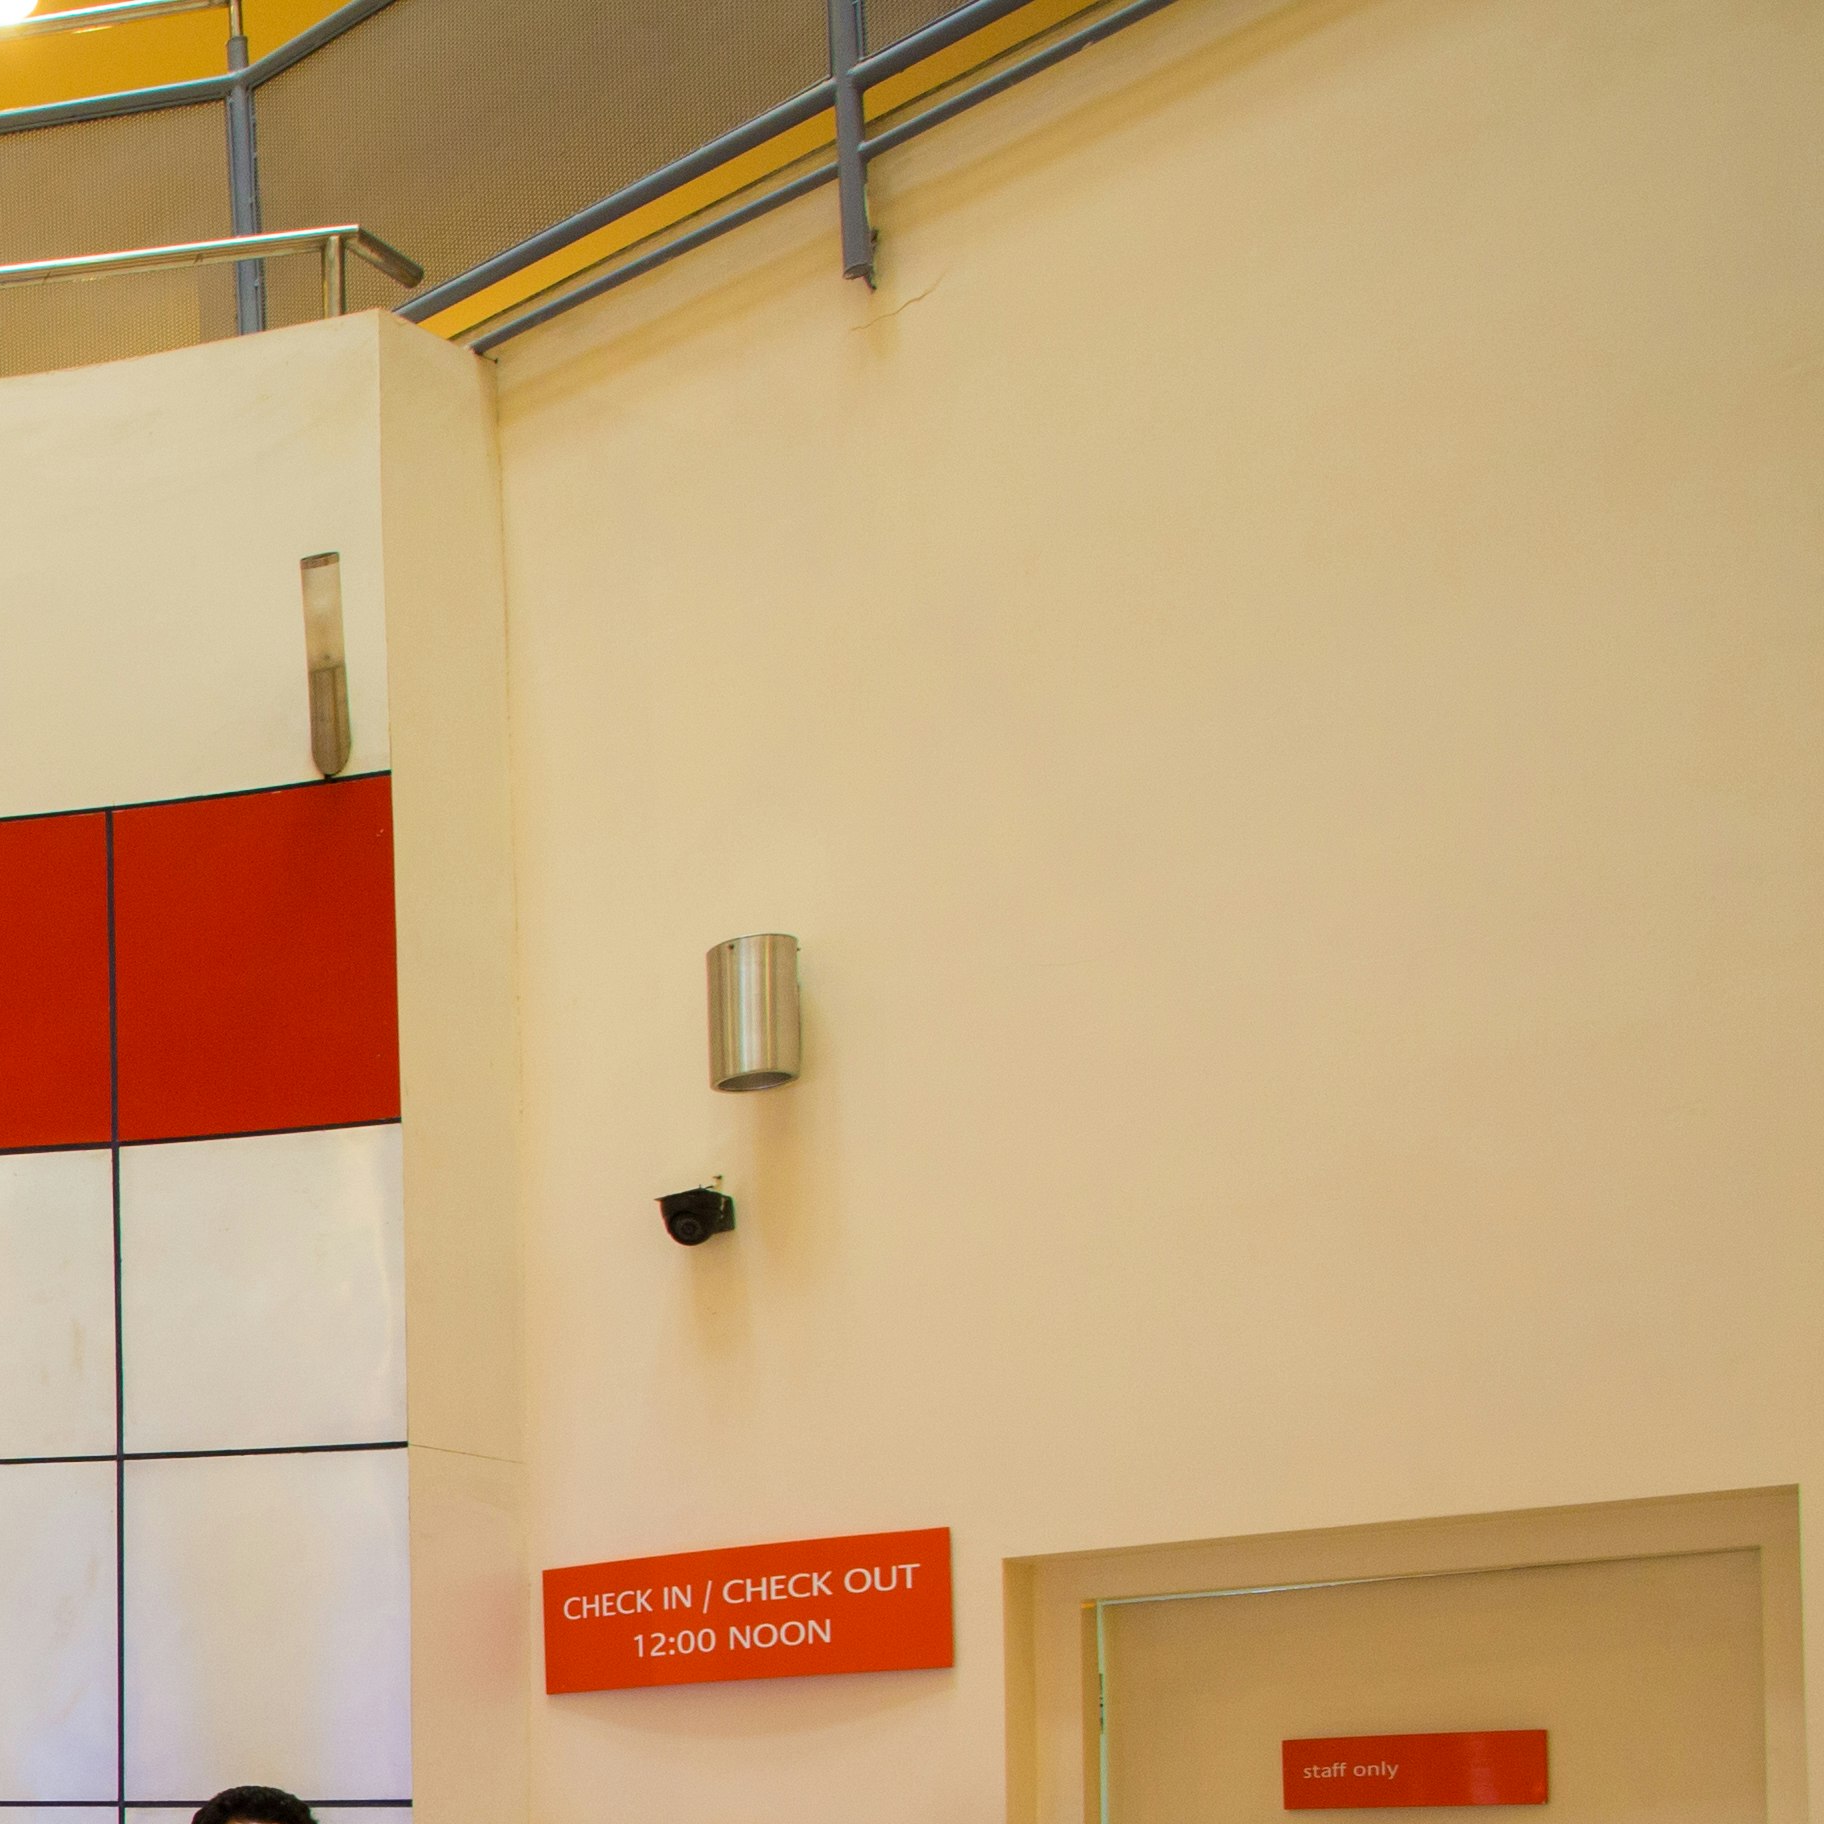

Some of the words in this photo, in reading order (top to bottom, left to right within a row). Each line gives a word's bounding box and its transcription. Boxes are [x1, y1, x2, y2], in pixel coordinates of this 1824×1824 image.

[563, 1589, 652, 1621] CHECK
[663, 1584, 692, 1610] IN
[701, 1580, 712, 1614] /
[722, 1571, 832, 1604] CHECK
[843, 1564, 920, 1593] OUT
[634, 1628, 716, 1658] 12:00
[729, 1619, 831, 1650] NOON
[1303, 1762, 1347, 1779] staff
[1353, 1761, 1398, 1780] only
